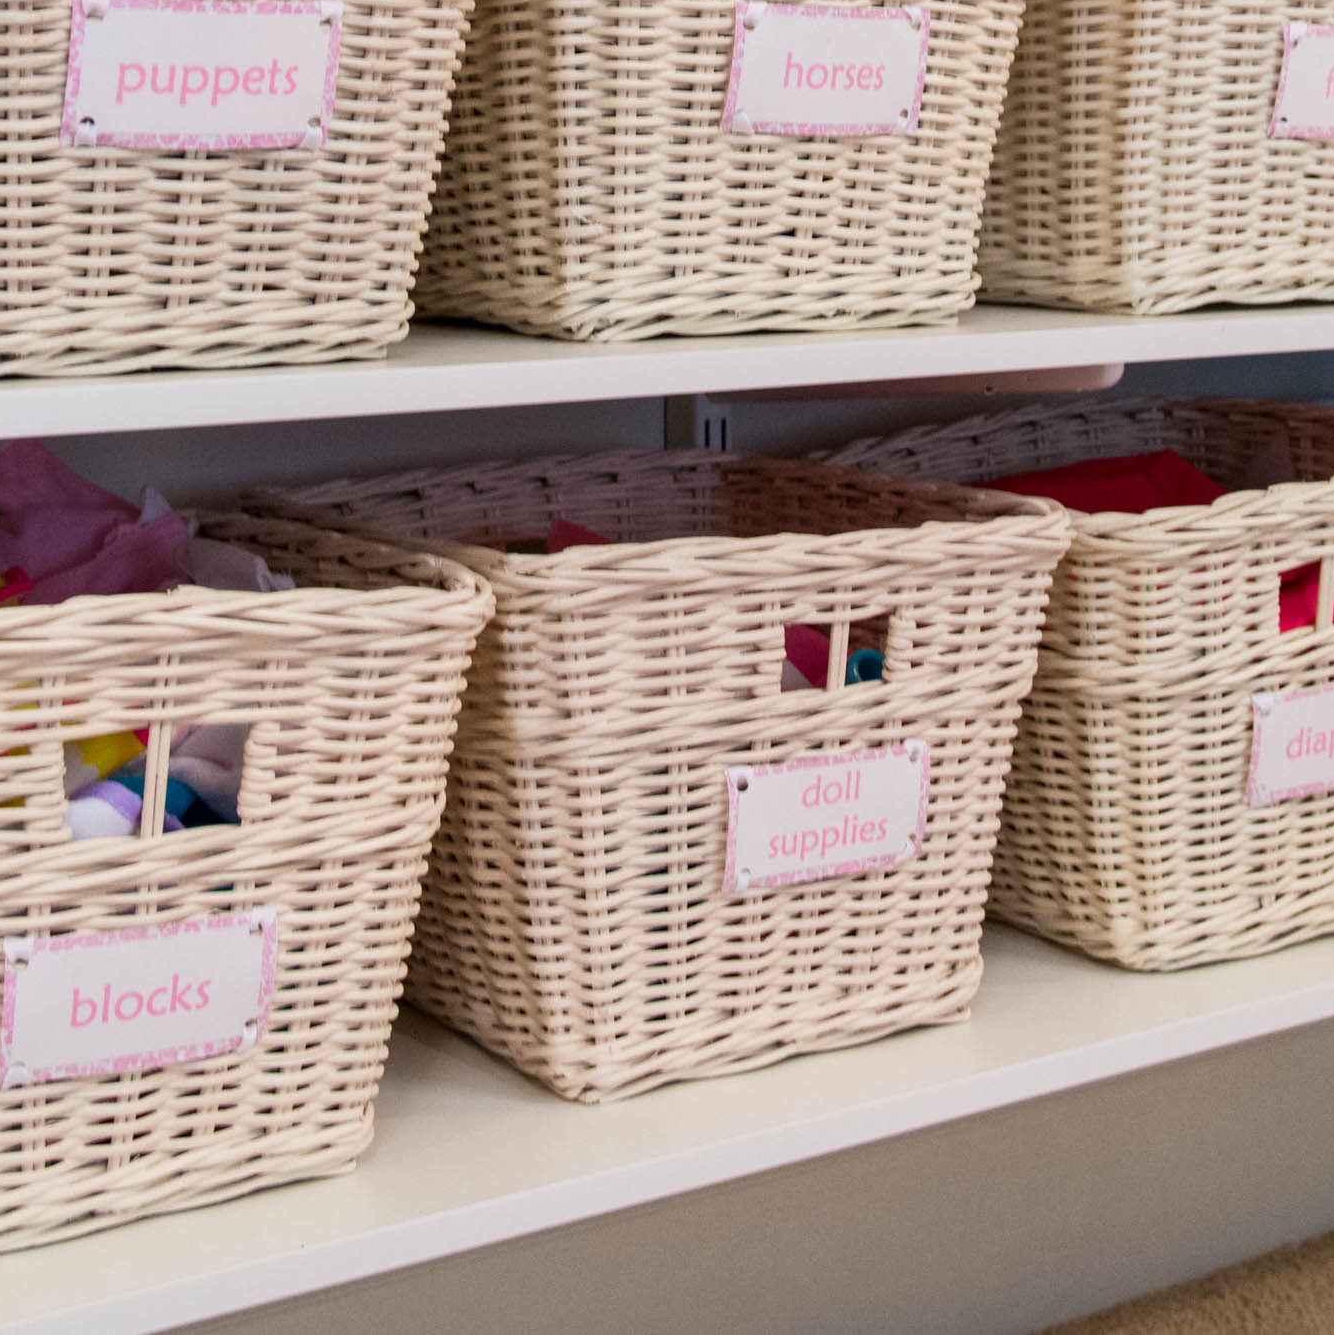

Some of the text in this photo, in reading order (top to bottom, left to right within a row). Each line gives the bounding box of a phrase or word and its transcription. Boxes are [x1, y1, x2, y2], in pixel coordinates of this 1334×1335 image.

[115, 58, 299, 106] puppets
[782, 51, 886, 90] horses
[801, 768, 861, 808] doll
[768, 815, 888, 860] supplies
[70, 972, 211, 1028] blocks
